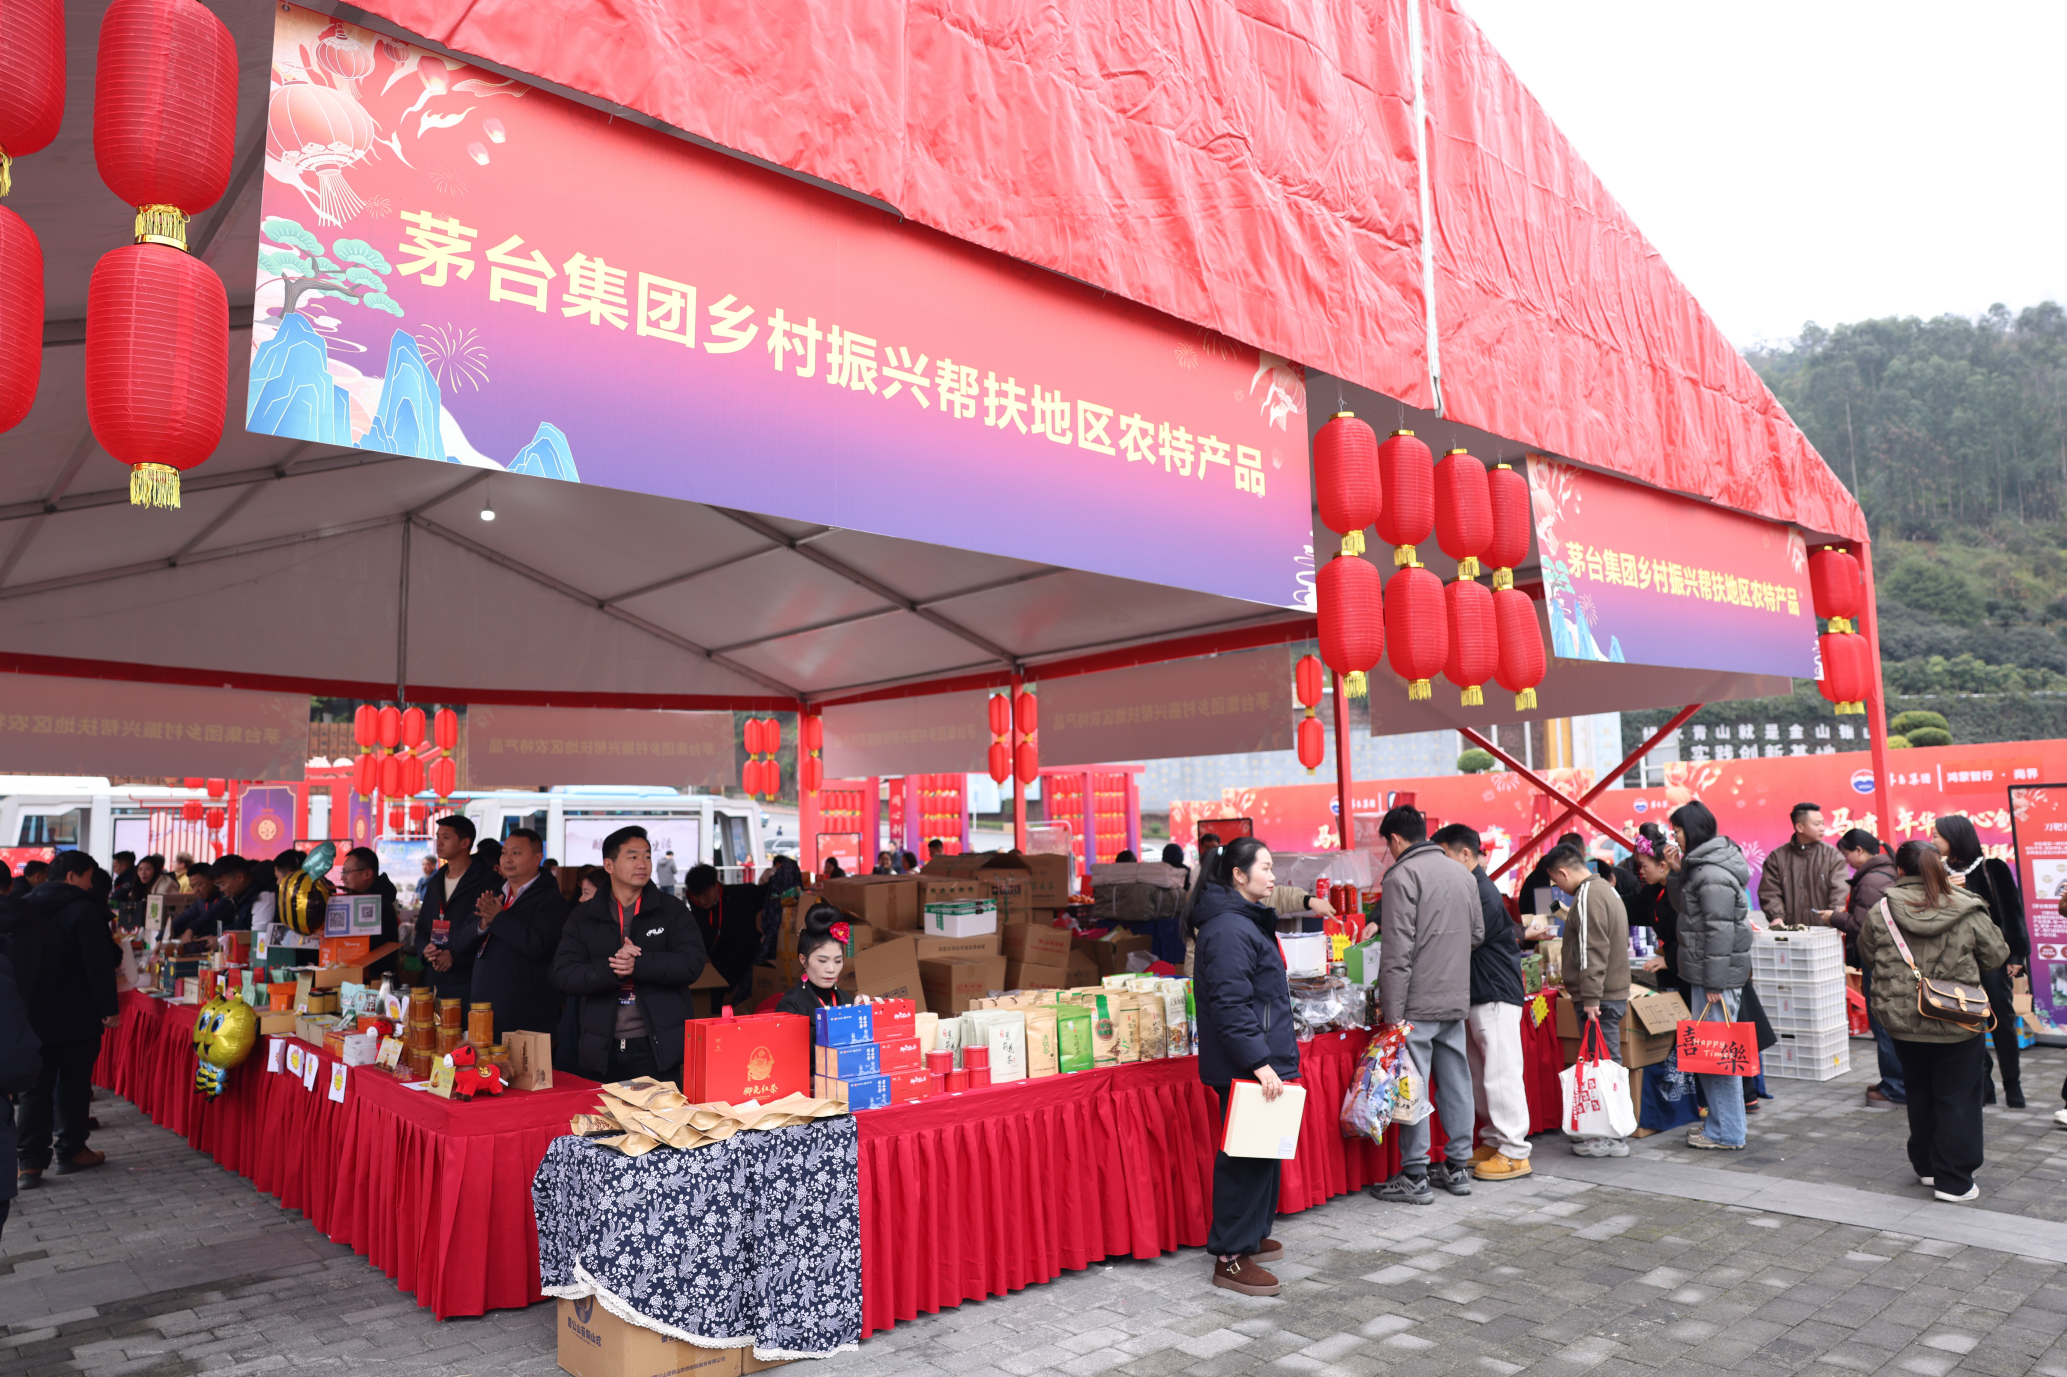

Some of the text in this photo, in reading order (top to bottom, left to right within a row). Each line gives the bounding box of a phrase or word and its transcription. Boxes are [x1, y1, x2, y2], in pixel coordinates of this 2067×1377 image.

[396, 209, 1267, 497] 茅台集团乡村振兴帮扶地区农特产品
[1566, 541, 1801, 616] 茅台集团乡村振兴帮扶地区农特产品
[646, 927, 665, 938] FILA
[1676, 1026, 1702, 1057] 喜
[1717, 1041, 1750, 1074] 樂
[1692, 1037, 1726, 1049] Happy
[1703, 1049, 1735, 1059] Times
